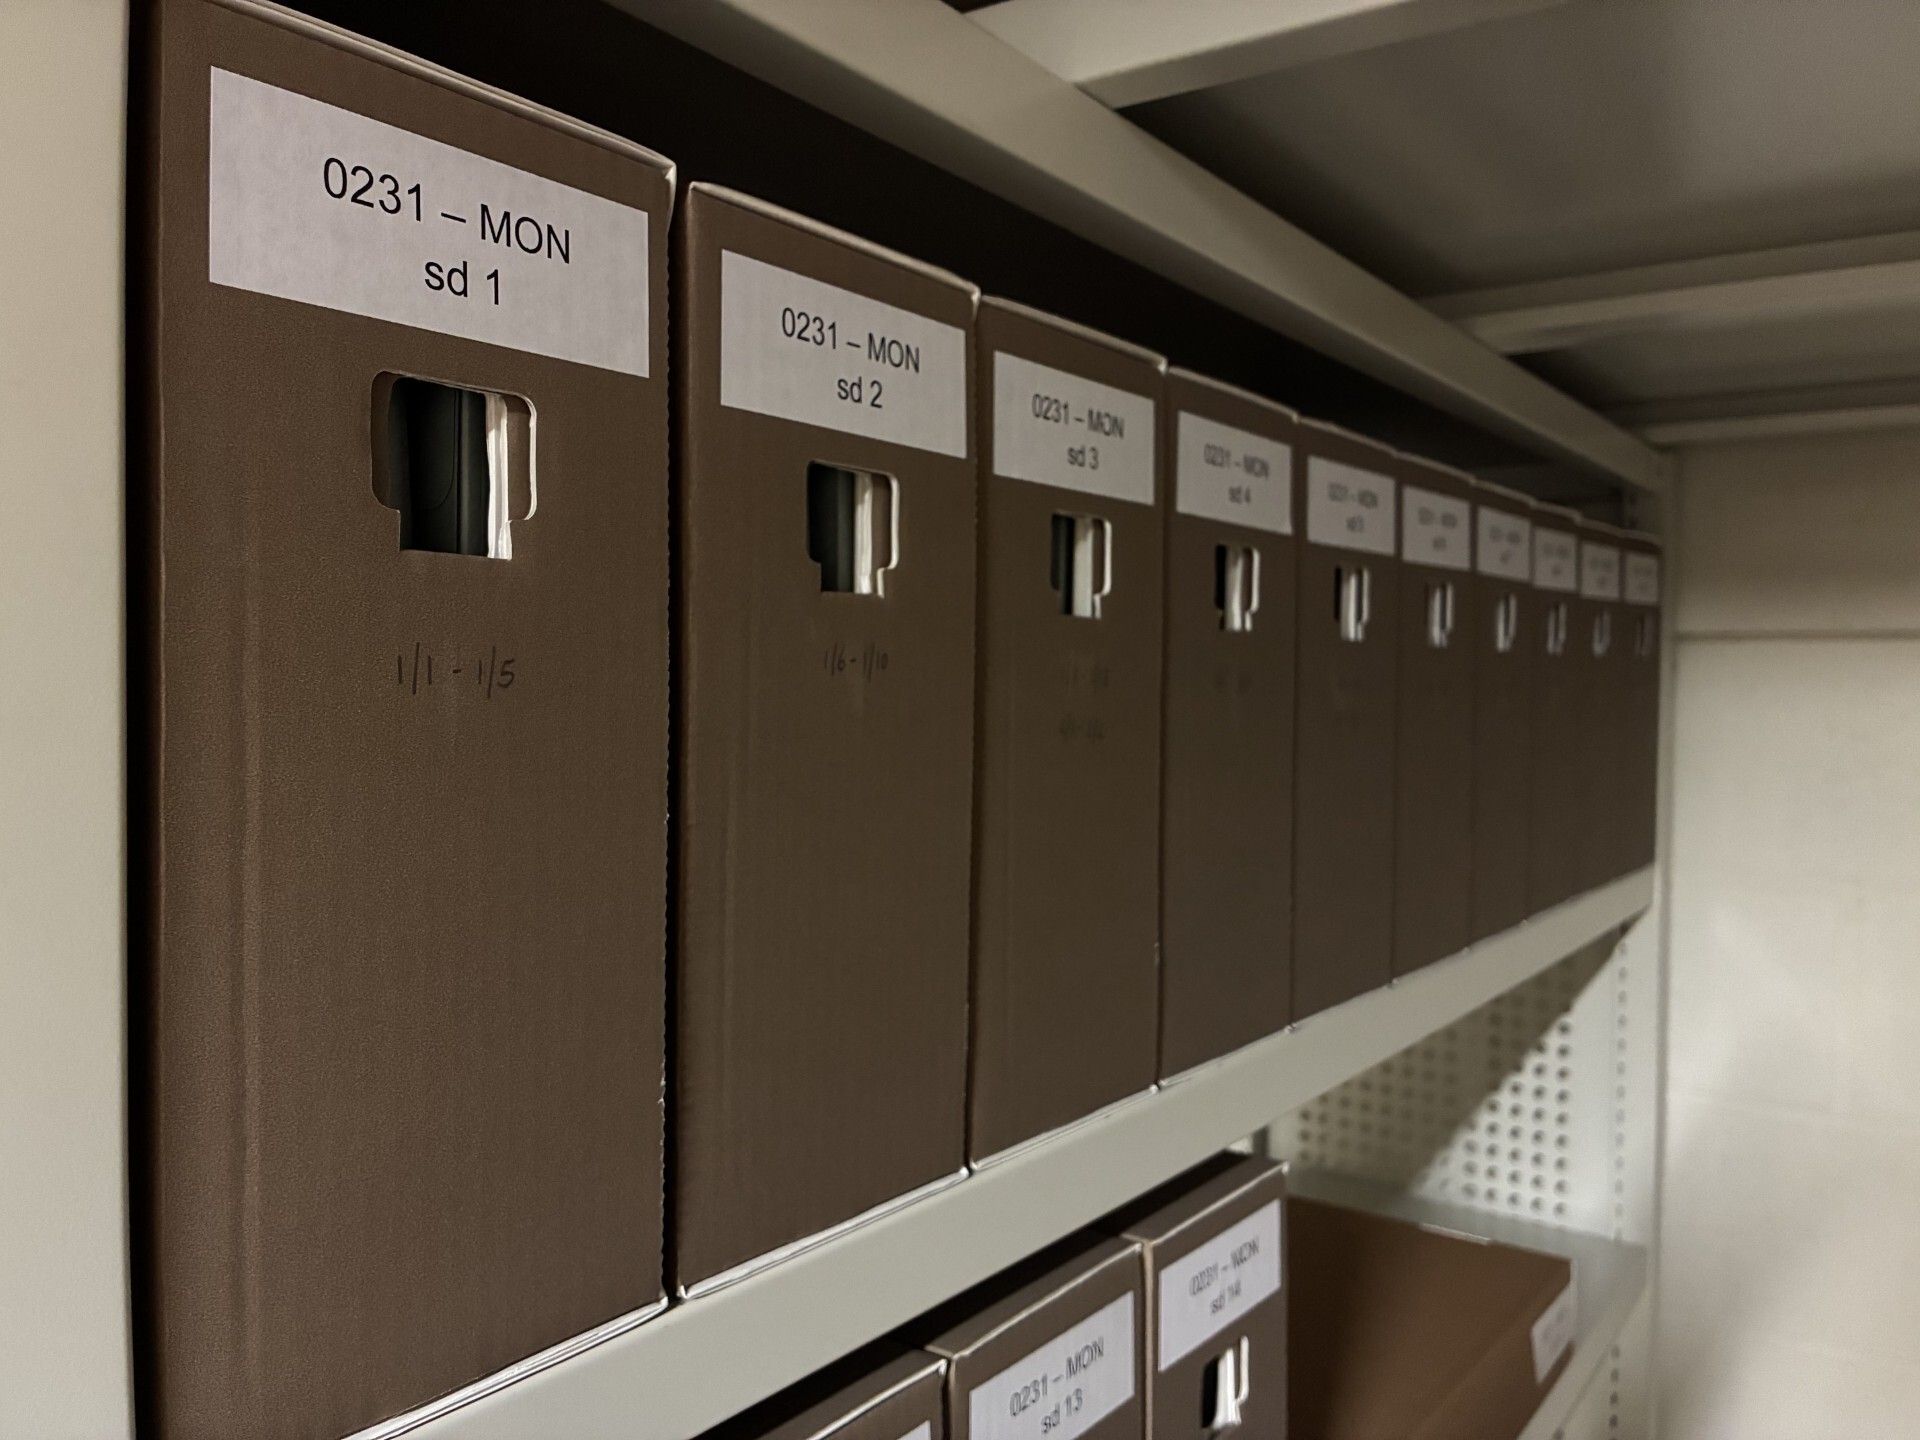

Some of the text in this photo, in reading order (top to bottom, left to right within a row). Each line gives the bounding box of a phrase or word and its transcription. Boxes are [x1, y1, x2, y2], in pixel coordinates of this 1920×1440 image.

[323, 157, 421, 222] 0231
[480, 203, 570, 264] MON
[424, 260, 500, 305] sd 1
[782, 307, 836, 349] 0231
[867, 332, 920, 373] MON
[837, 376, 883, 408] sd 2
[1031, 393, 1069, 425] 0231
[1087, 407, 1126, 440] MON
[1067, 445, 1099, 470] sd 3
[397, 641, 433, 695] 1/1
[476, 646, 515, 698] 1/5
[1010, 1373, 1048, 1416] 0231
[1065, 1336, 1105, 1381] MON
[1041, 1388, 1083, 1434] sd 13
